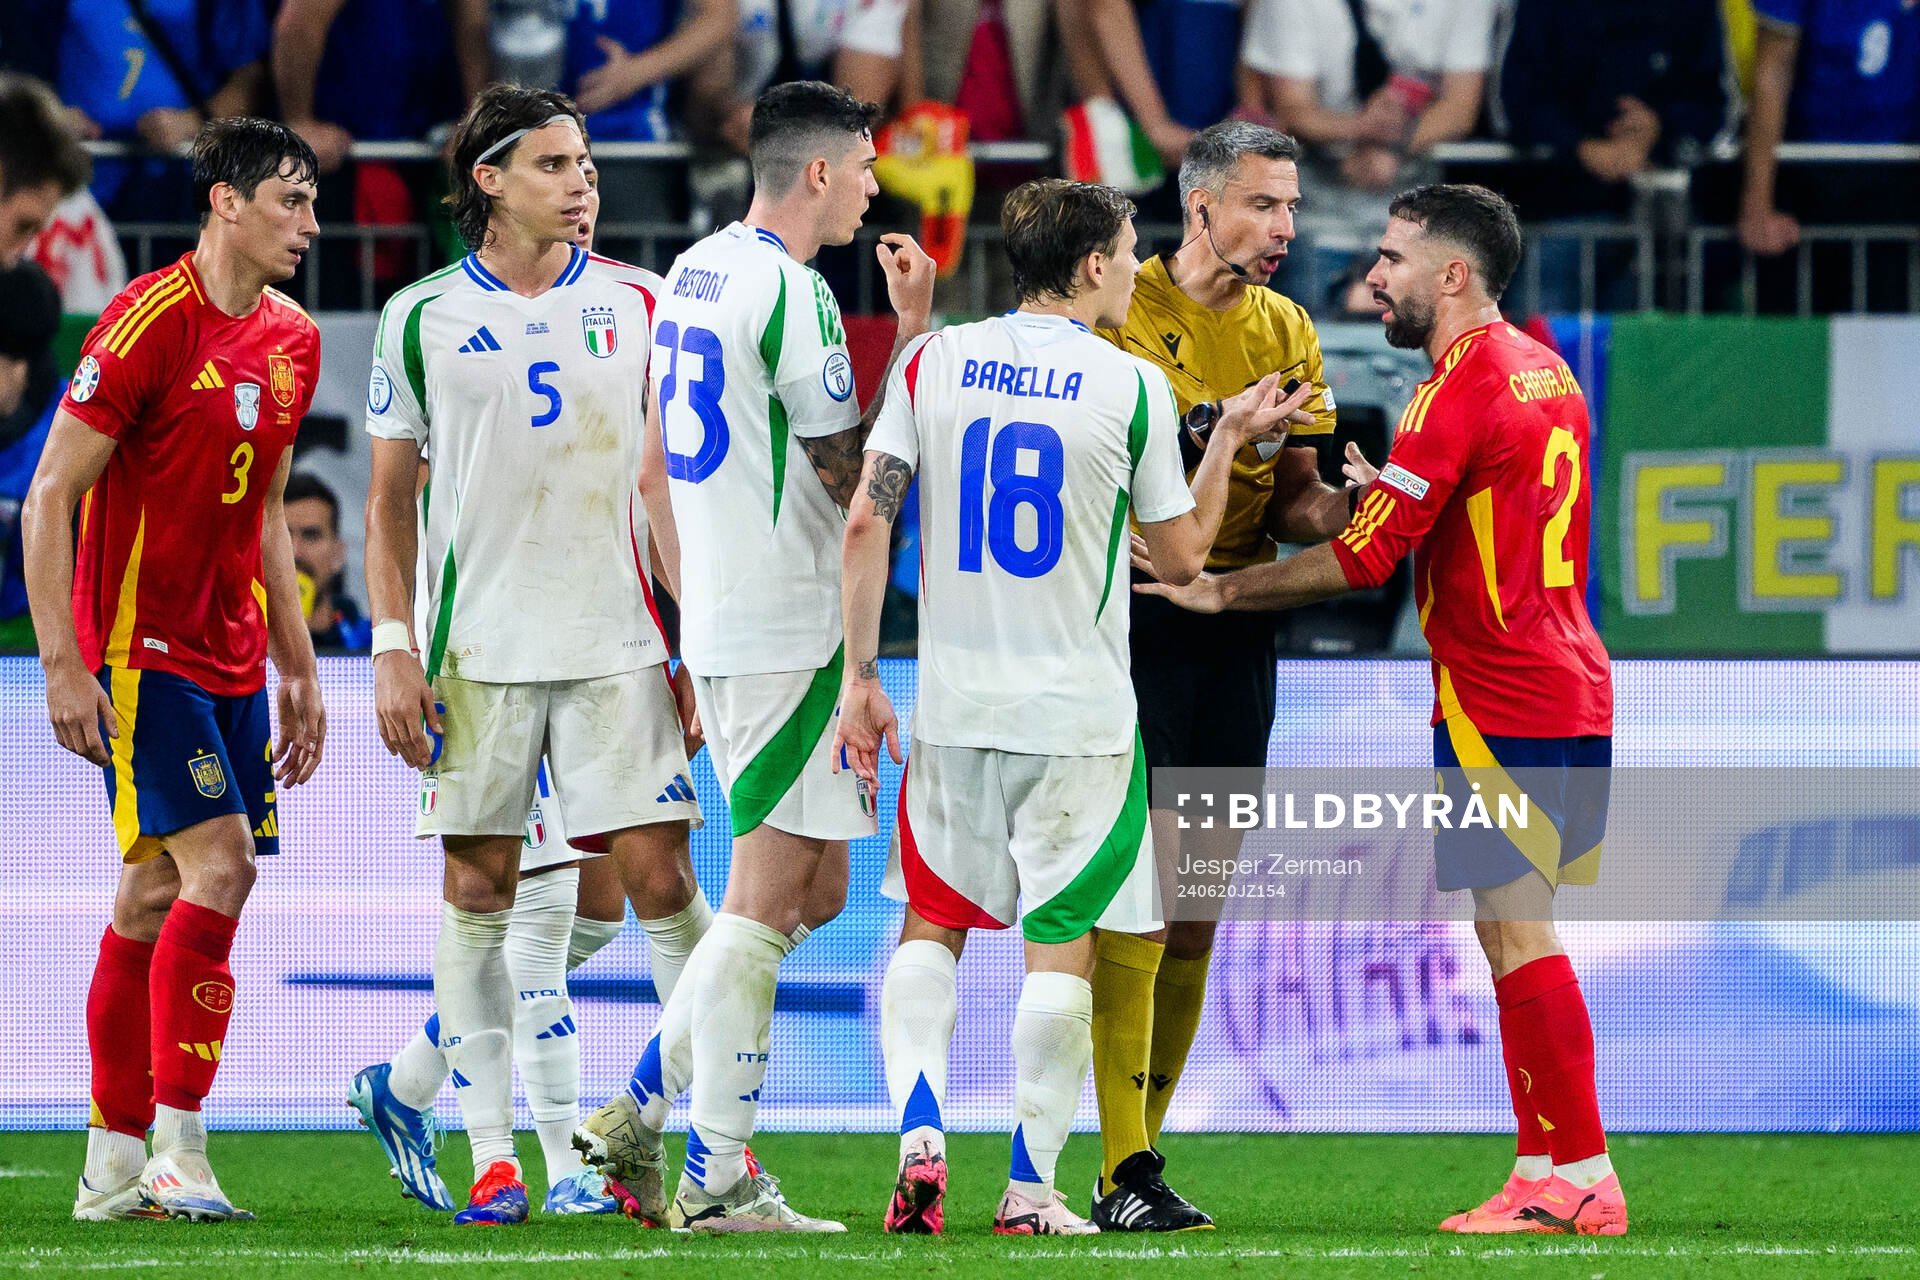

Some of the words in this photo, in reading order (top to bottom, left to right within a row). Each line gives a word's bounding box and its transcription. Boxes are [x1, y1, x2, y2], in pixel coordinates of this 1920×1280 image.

[673, 266, 729, 303] BASTONI
[584, 316, 613, 327] ITALIA
[528, 361, 562, 427] 5
[655, 320, 730, 484] 23
[961, 359, 1083, 401] BARELLA
[222, 441, 255, 504] 3
[958, 417, 1064, 578] 18
[1542, 426, 1580, 588] 2
